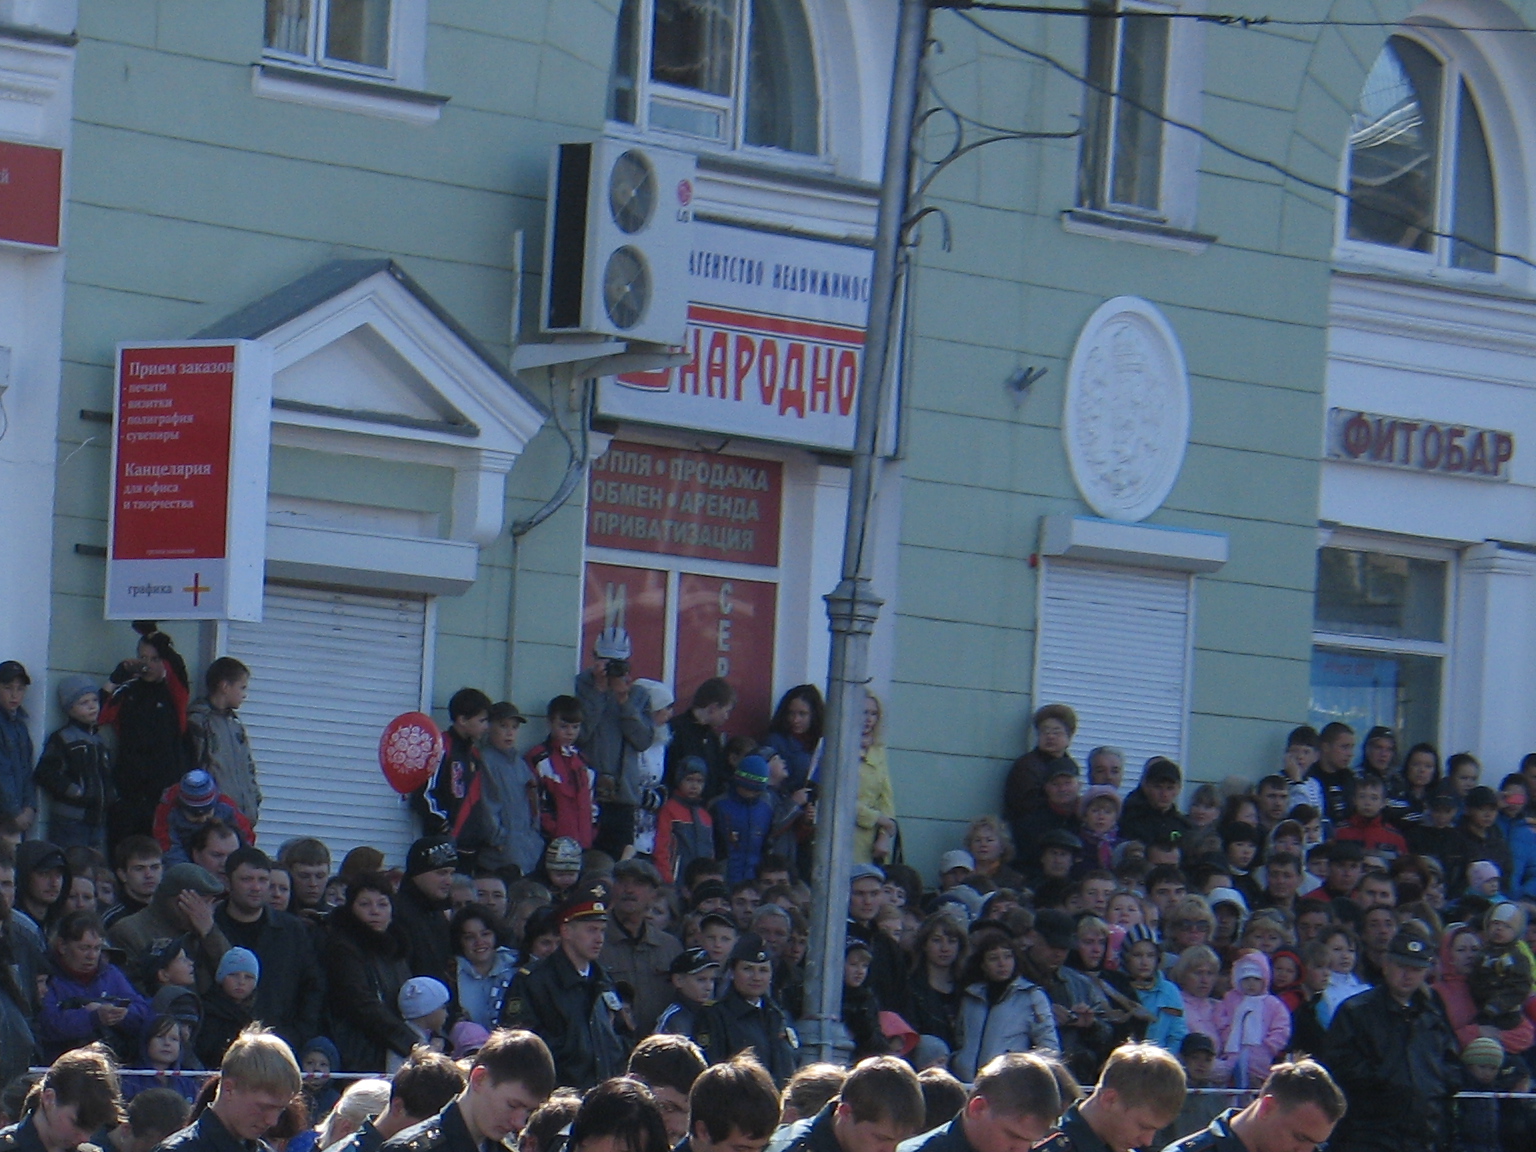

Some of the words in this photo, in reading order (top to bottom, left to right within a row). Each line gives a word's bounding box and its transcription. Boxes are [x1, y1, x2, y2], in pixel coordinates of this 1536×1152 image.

[688, 250, 763, 286] АГЕНТСТВО
[129, 361, 177, 379] Прием
[179, 361, 234, 375] заказов
[126, 431, 179, 443] сувениры
[1344, 411, 1513, 476] ФИТОБАР
[125, 463, 211, 479] Канцелярия
[593, 450, 652, 477] УПЛЯ
[669, 457, 770, 491] ПРОДАЖА
[124, 484, 142, 494] для
[145, 481, 179, 495] офиса
[133, 500, 194, 511] творчества
[592, 479, 662, 509] ОБМЕН
[680, 493, 759, 523] АРЕНДА
[593, 511, 754, 552] ПРИВАТИЗАЦИЯ
[127, 583, 173, 597] графика
